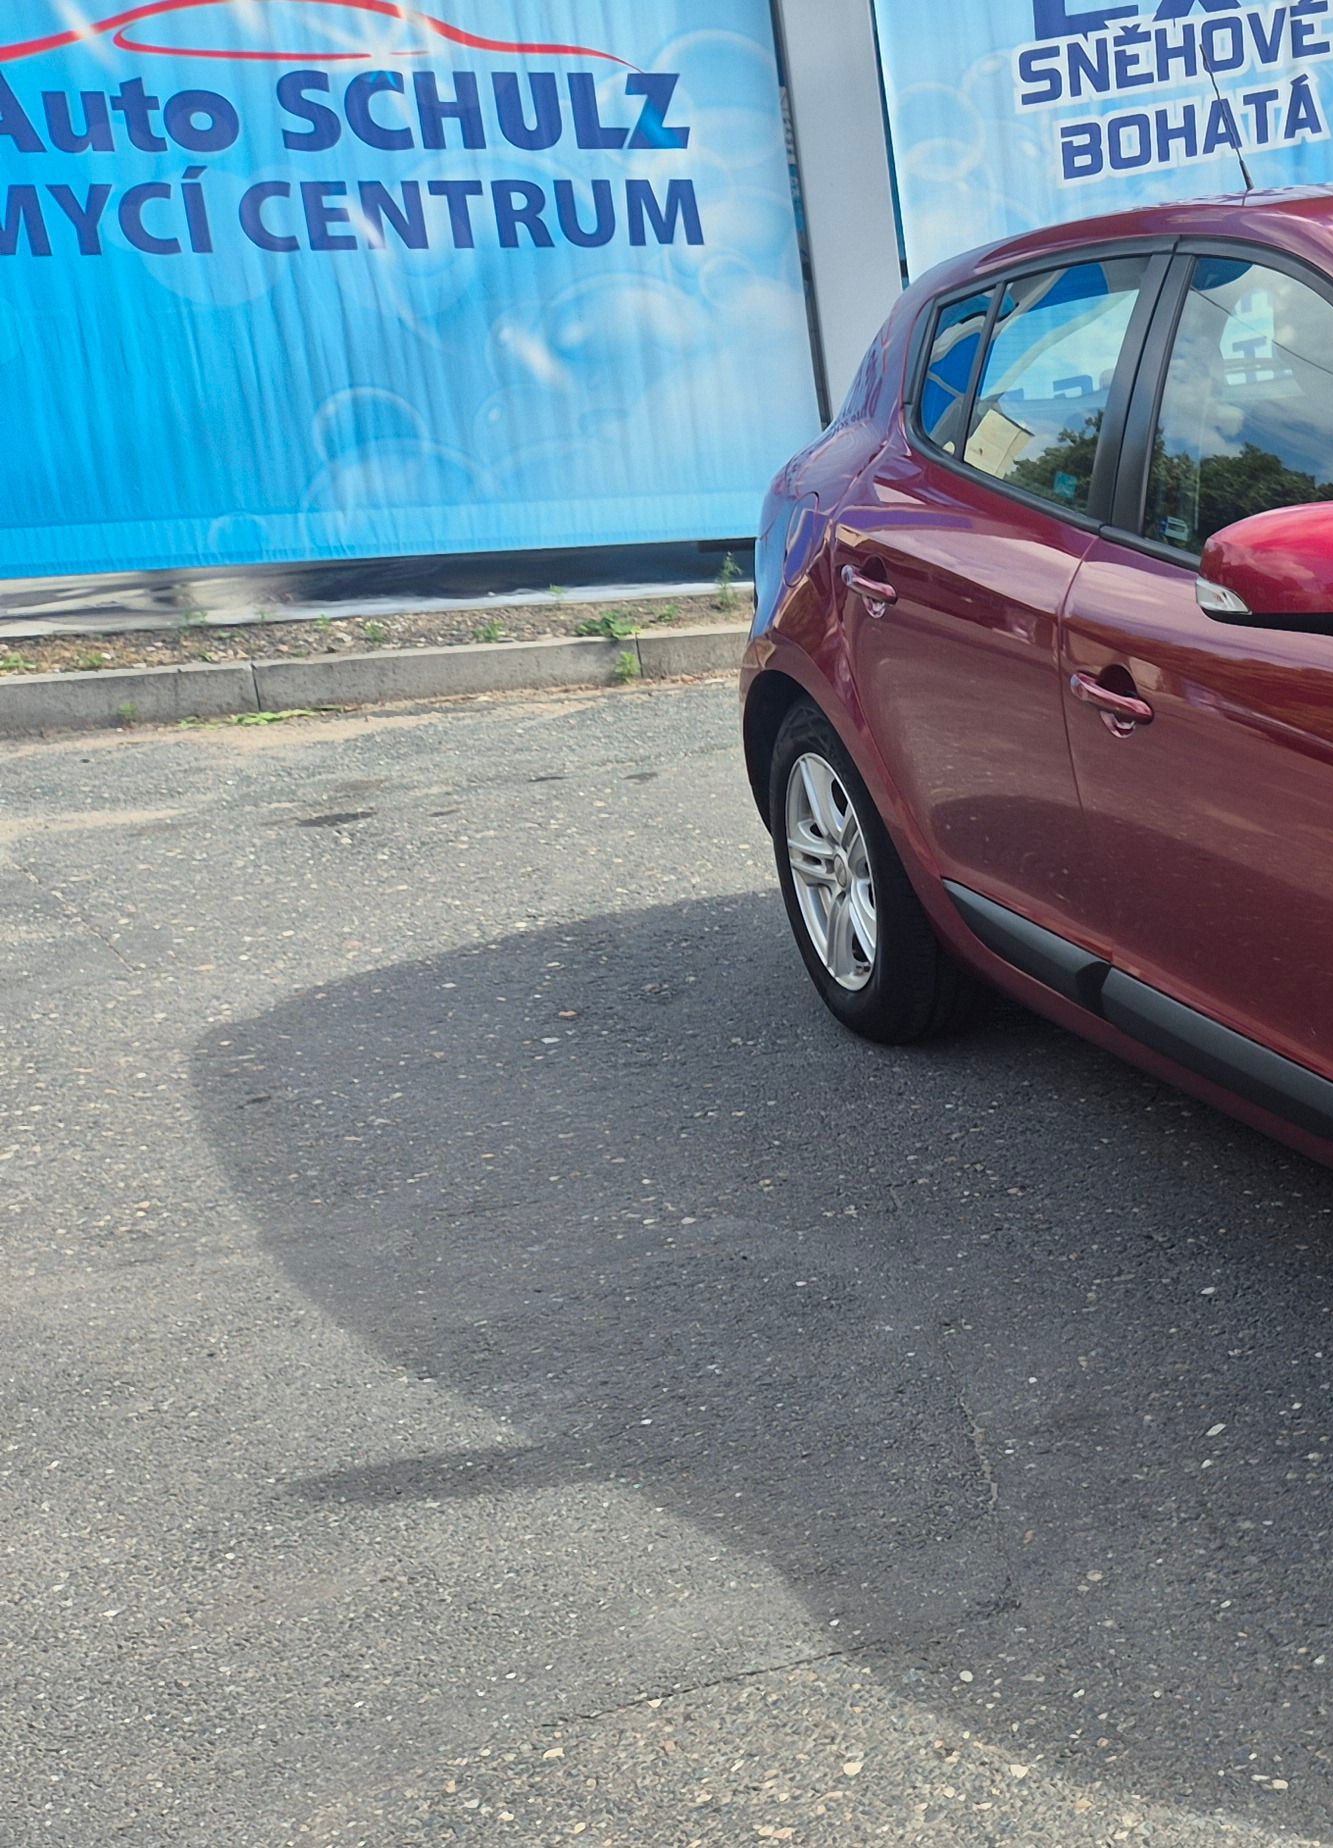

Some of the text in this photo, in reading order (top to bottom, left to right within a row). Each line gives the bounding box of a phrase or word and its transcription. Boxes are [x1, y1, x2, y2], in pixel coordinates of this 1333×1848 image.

[0, 69, 690, 153] Auto SCHULZ
[1060, 73, 1322, 180] BOHATÁ
[0, 165, 705, 257] MYCÍ CENTRUM
